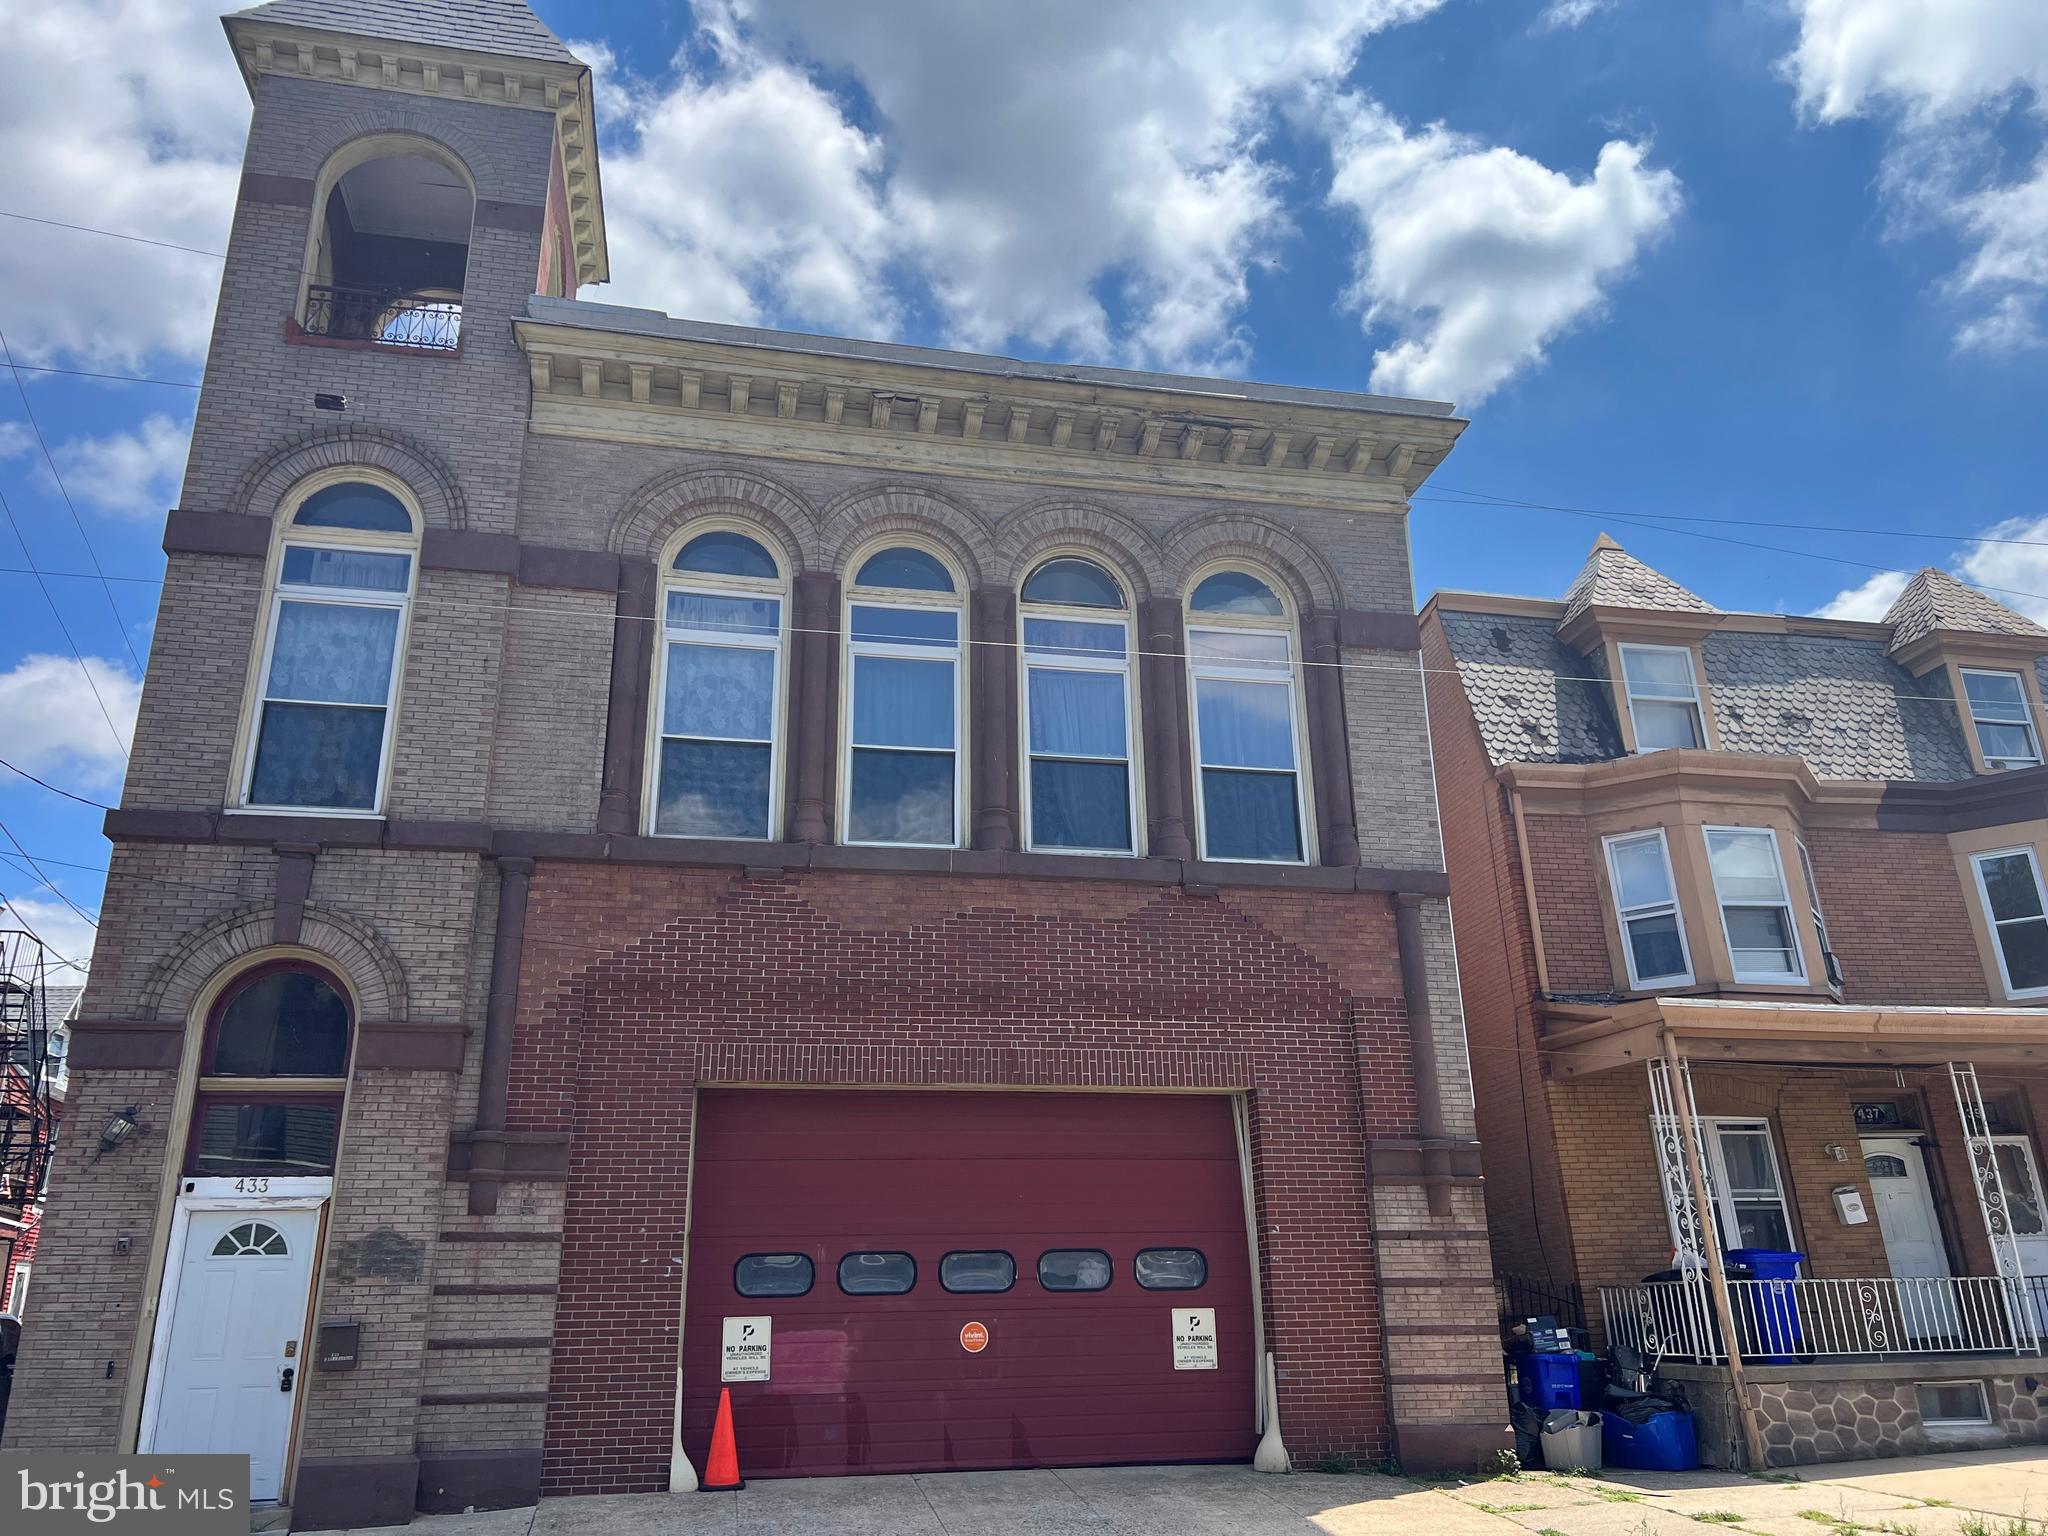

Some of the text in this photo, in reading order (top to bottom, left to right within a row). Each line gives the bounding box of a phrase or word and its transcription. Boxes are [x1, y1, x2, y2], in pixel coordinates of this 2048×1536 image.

[1857, 1108, 1879, 1119] 437
[235, 1178, 269, 1193] 433
[726, 1344, 767, 1353] NO PARKING
